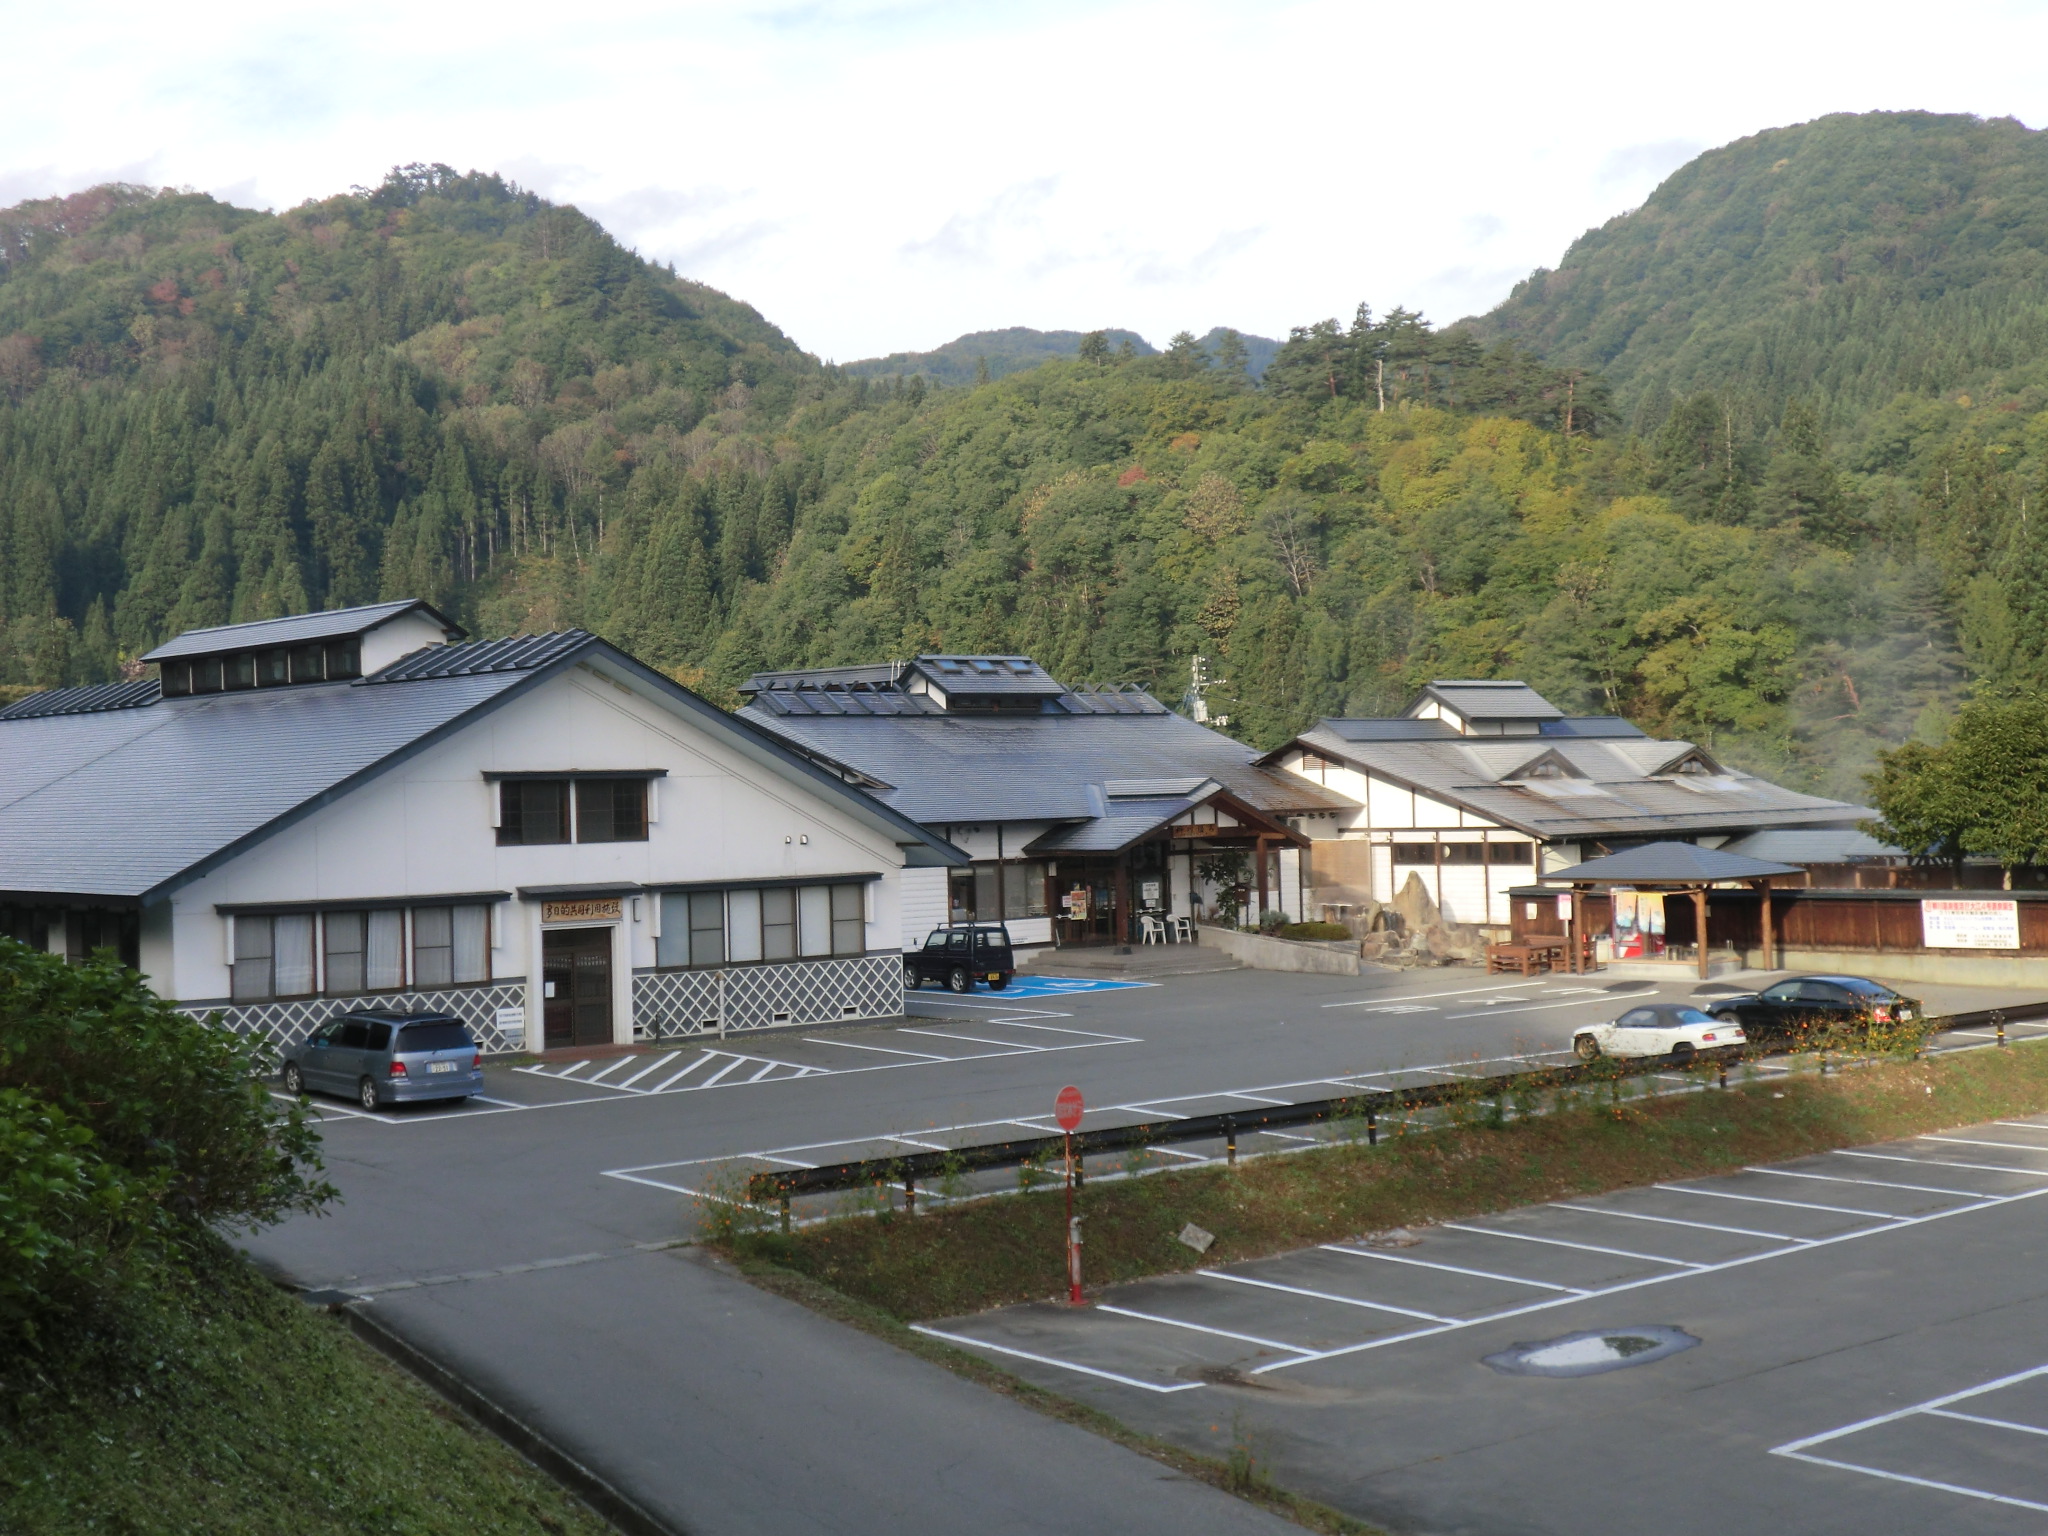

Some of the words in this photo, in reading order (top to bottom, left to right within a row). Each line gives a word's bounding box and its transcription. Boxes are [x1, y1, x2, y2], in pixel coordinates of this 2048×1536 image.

[546, 901, 620, 918] 多目的共同利用施設
